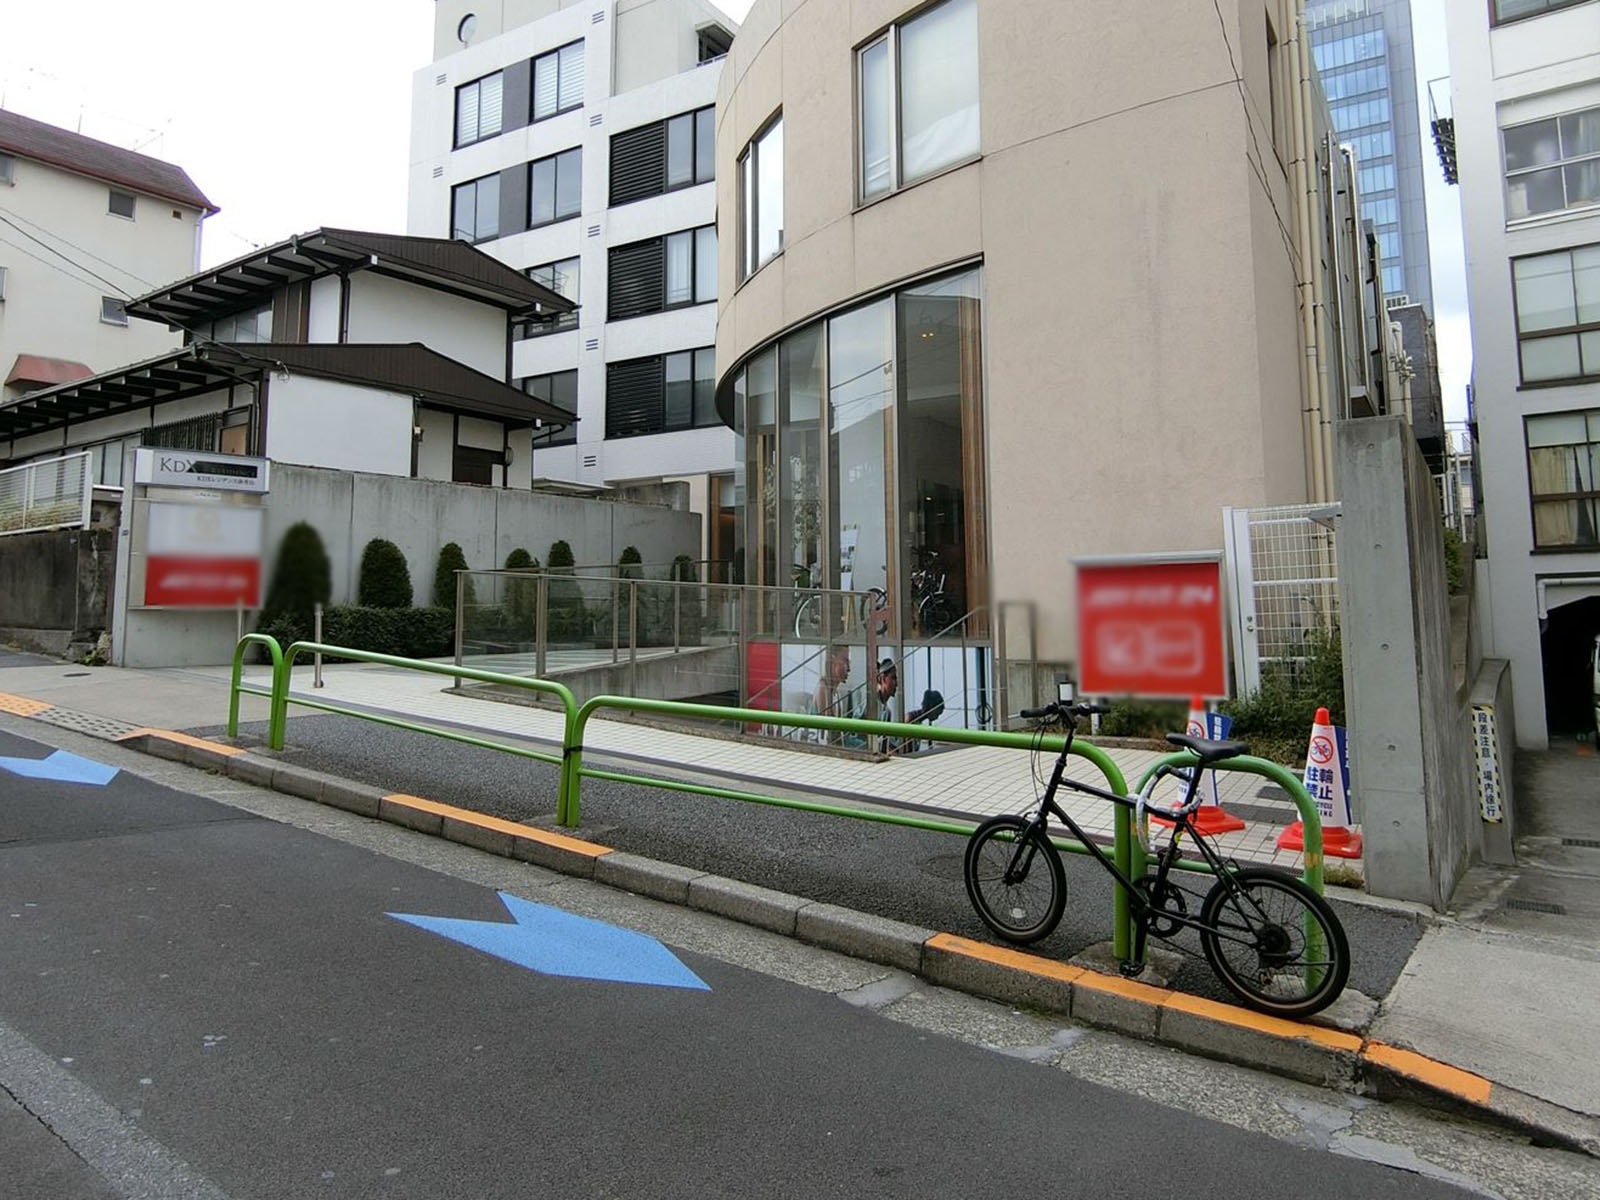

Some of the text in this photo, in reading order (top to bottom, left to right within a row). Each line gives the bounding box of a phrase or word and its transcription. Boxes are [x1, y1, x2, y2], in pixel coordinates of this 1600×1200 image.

[160, 457, 197, 473] KDX
[1306, 766, 1333, 784] 駐輪
[1306, 782, 1333, 801] 禁止
